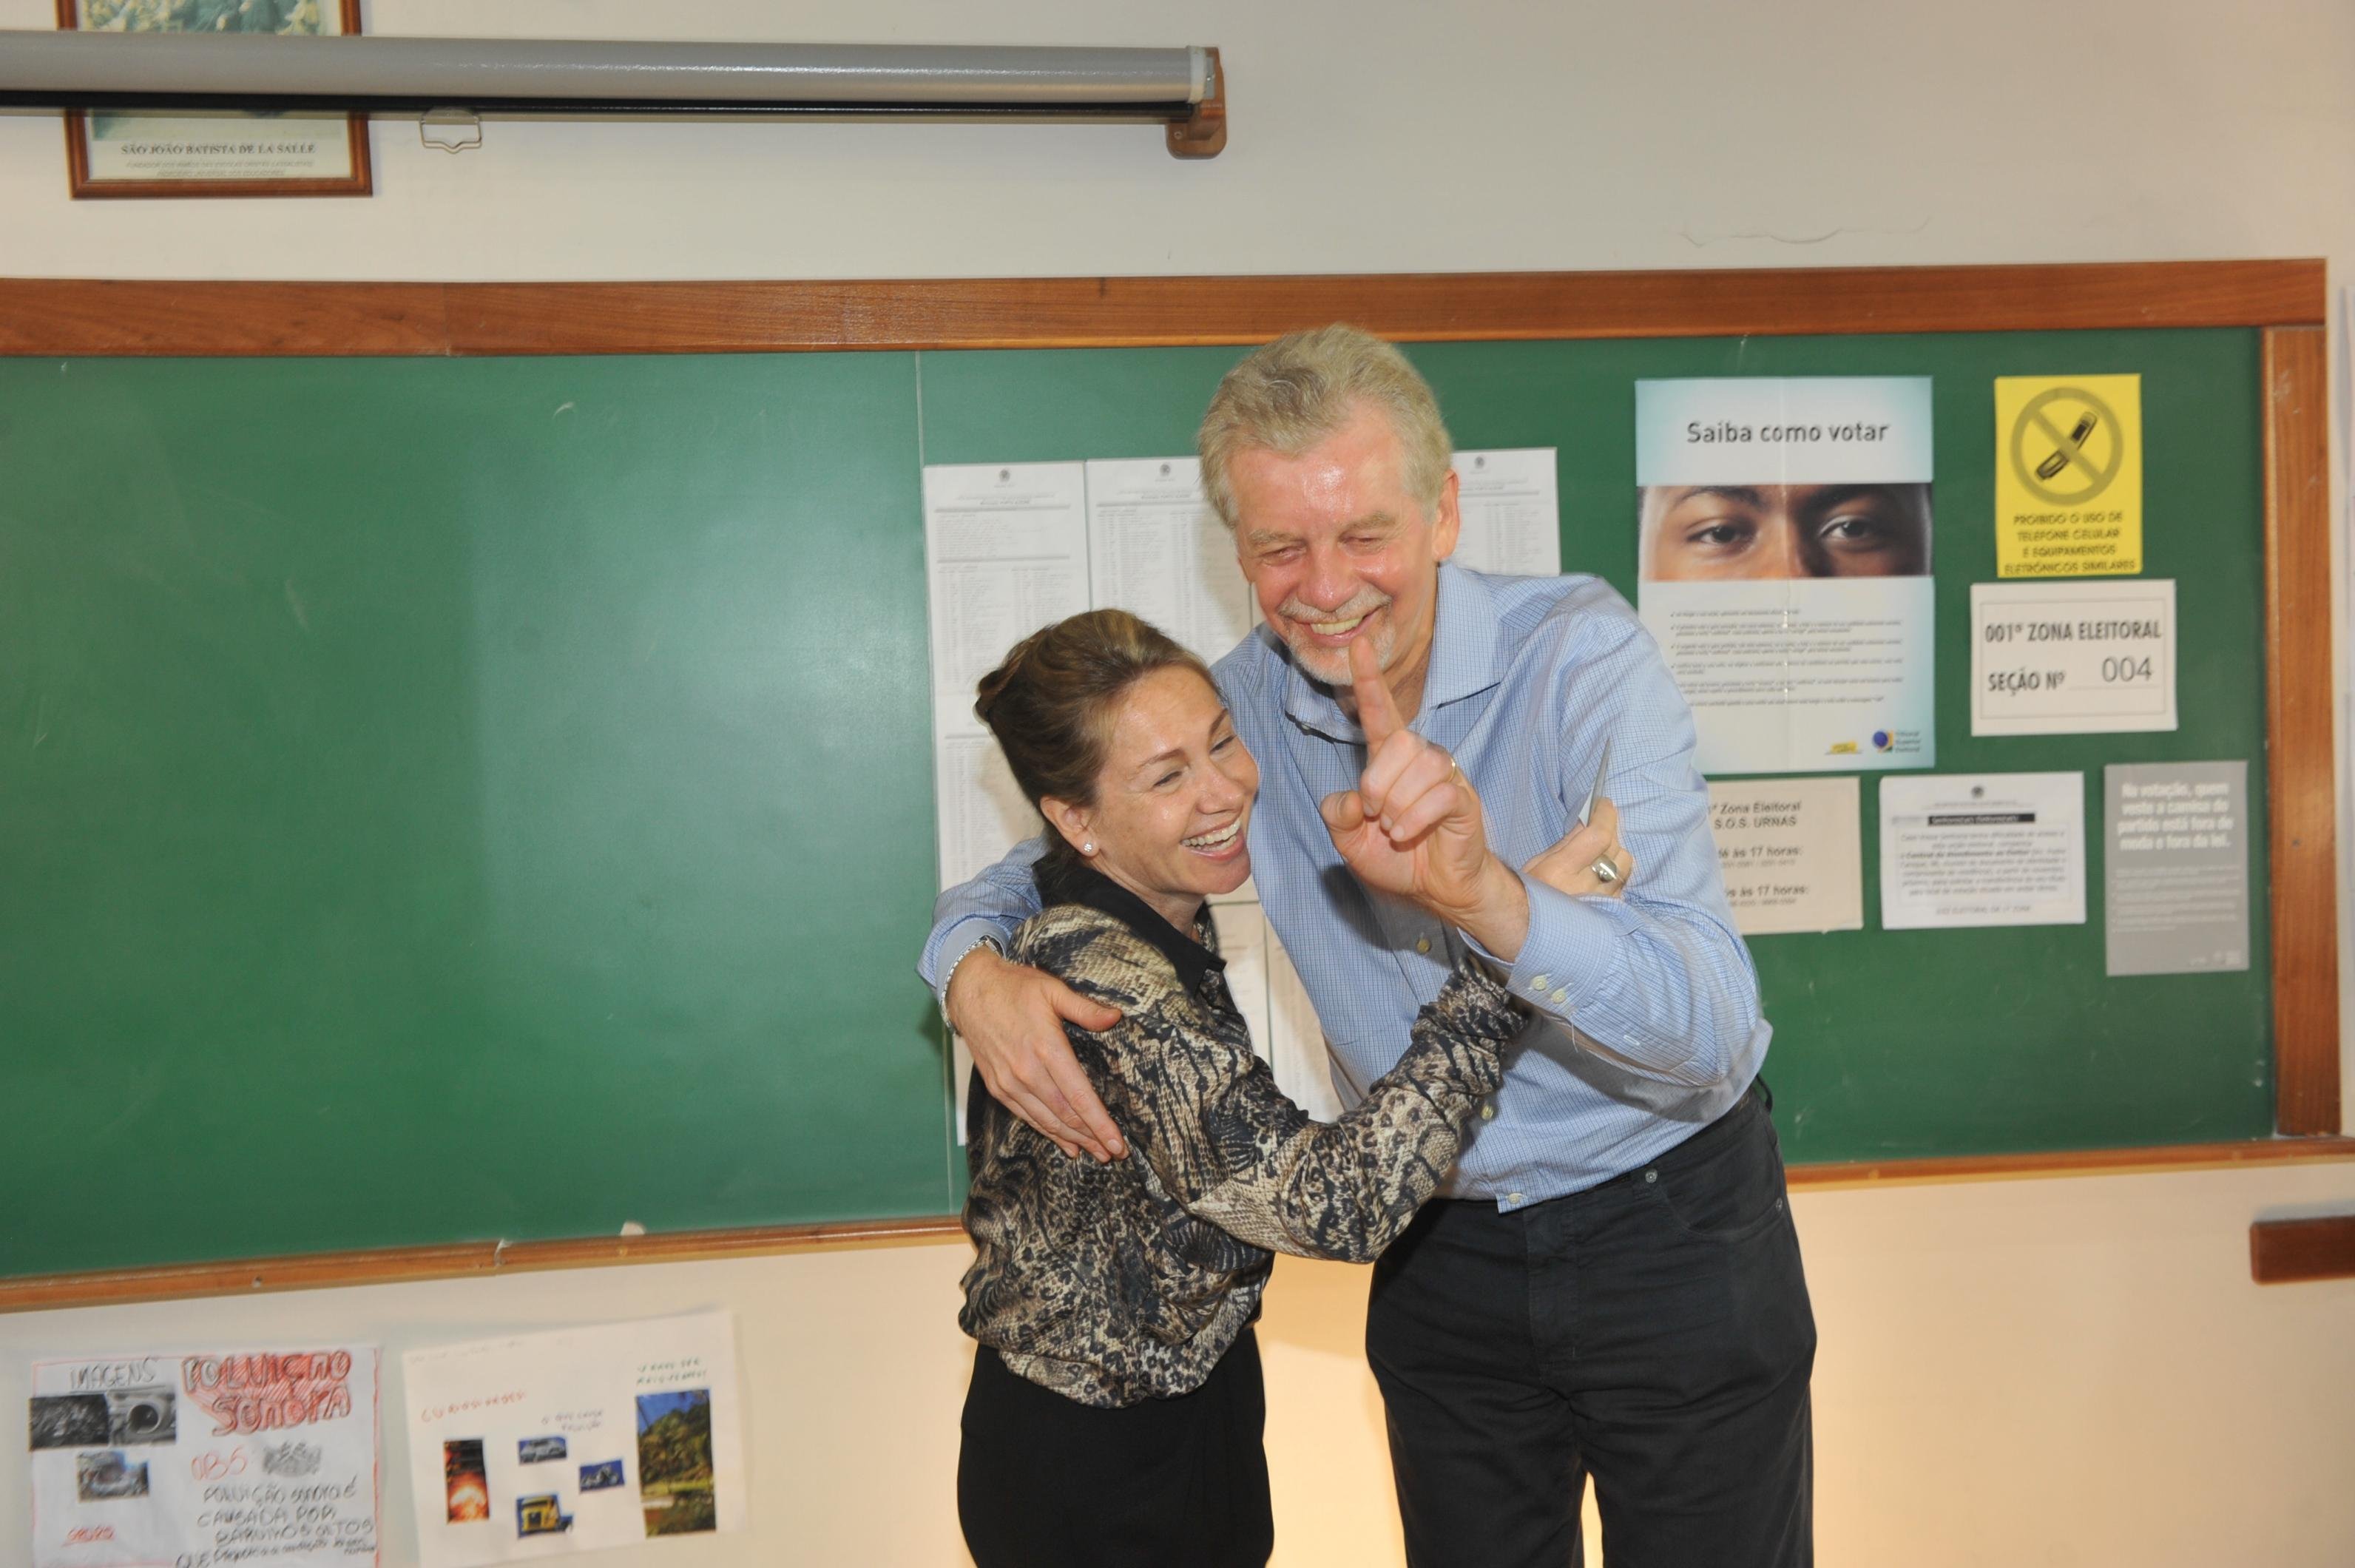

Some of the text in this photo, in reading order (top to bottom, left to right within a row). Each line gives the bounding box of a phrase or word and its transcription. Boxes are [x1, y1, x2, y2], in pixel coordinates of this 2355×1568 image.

[121, 143, 314, 155] SÃO JOÃO BATISTA DE LA SALLE
[1687, 422, 1888, 442] Saiba como votar
[2013, 511, 2123, 526] PROIBIDO O USO DE
[2017, 528, 2120, 541] TELEFONE CELULAR
[2023, 545, 2115, 558] E EQUIPAMENTOS
[2082, 560, 2135, 571] SIMILARES
[2027, 623, 2072, 642] ZONA
[2078, 621, 2160, 641] ELEITORAL
[2101, 655, 2152, 683] 004
[1720, 802, 1748, 815] Zona
[1753, 800, 1802, 814] Eleitoral
[1714, 816, 1797, 829] S.O.S. URNAS
[2118, 817, 2159, 836] partido
[2191, 815, 2215, 831] fora
[2166, 834, 2190, 849] fora
[1751, 845, 1763, 857] 17
[1766, 845, 1804, 857] horas:
[1757, 885, 1770, 896] 17
[1774, 884, 1809, 896] horas:
[70, 1356, 156, 1389] IMAGENS
